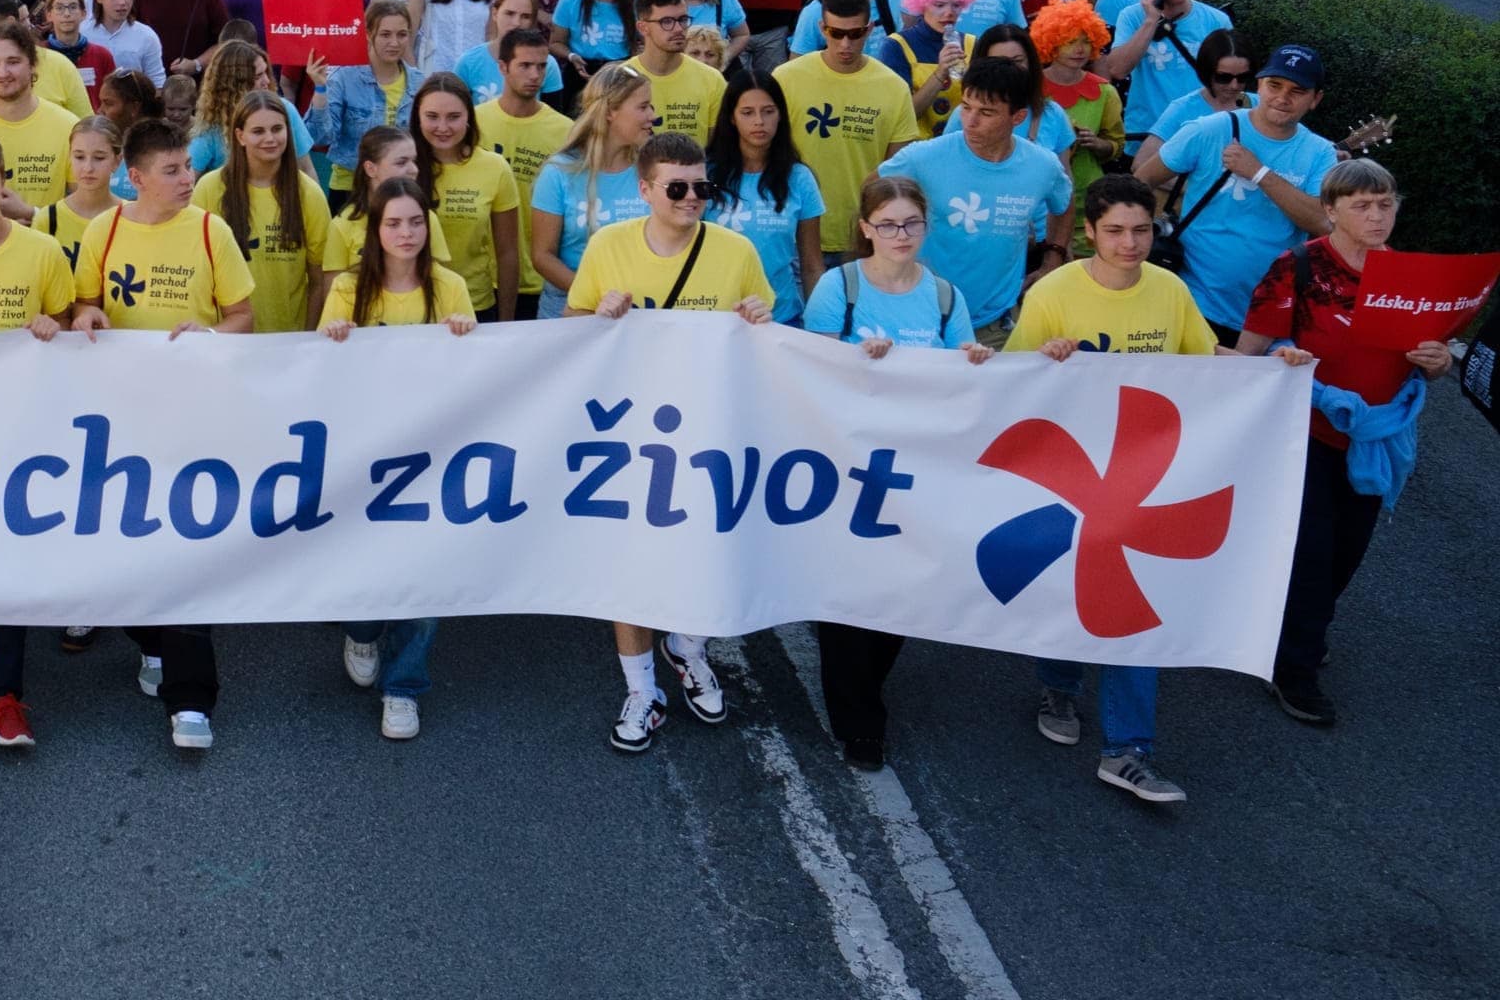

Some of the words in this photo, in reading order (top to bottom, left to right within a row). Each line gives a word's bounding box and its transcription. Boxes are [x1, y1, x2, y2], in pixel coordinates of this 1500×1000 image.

[270, 22, 301, 34] Láska
[302, 23, 312, 38] je
[314, 27, 327, 35] za
[328, 24, 357, 35] život
[666, 102, 700, 112] národný
[844, 105, 881, 117] národný
[666, 111, 696, 121] pochod
[843, 115, 874, 126] pochod
[679, 122, 698, 130] život
[854, 125, 875, 135] život
[18, 154, 56, 165] národný
[18, 164, 49, 174] pochod
[30, 175, 51, 184] život
[445, 188, 480, 198] národný
[445, 197, 474, 206] pochod
[457, 204, 477, 213] život
[151, 264, 195, 280] národný
[150, 275, 187, 288] pochod
[150, 290, 162, 298] za
[163, 290, 190, 301] život
[675, 295, 719, 307] národný
[1364, 294, 1414, 310] Láska
[1413, 299, 1433, 315] je
[1434, 301, 1452, 312] za
[1, 307, 26, 319] život
[1127, 328, 1168, 342] národný
[366, 441, 529, 525] za
[563, 399, 914, 539] život
